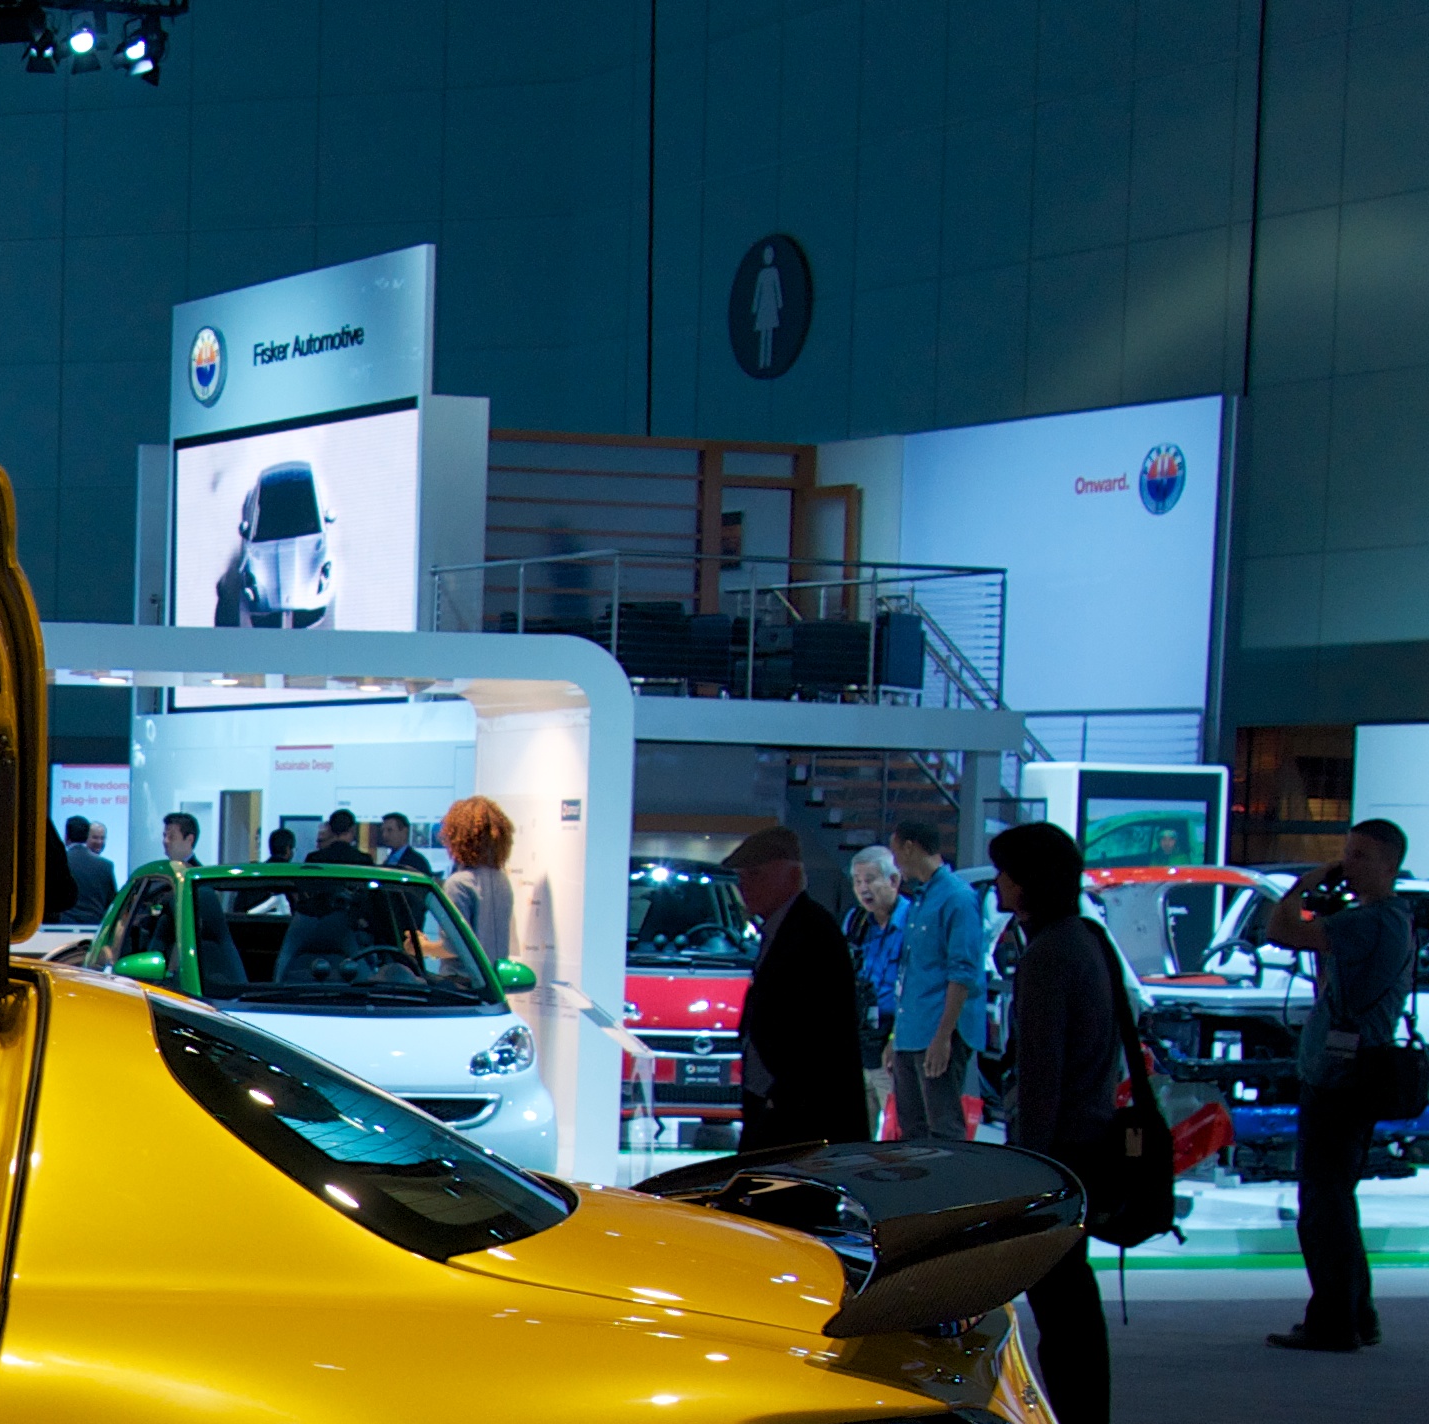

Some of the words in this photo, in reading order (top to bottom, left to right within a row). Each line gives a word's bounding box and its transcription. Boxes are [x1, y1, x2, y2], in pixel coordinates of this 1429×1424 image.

[252, 340, 291, 367] Fisker
[292, 324, 365, 359] Automotive
[1075, 472, 1130, 495] Onward.
[274, 760, 310, 771] Sustainable
[312, 760, 334, 772] Design
[61, 780, 82, 790] The
